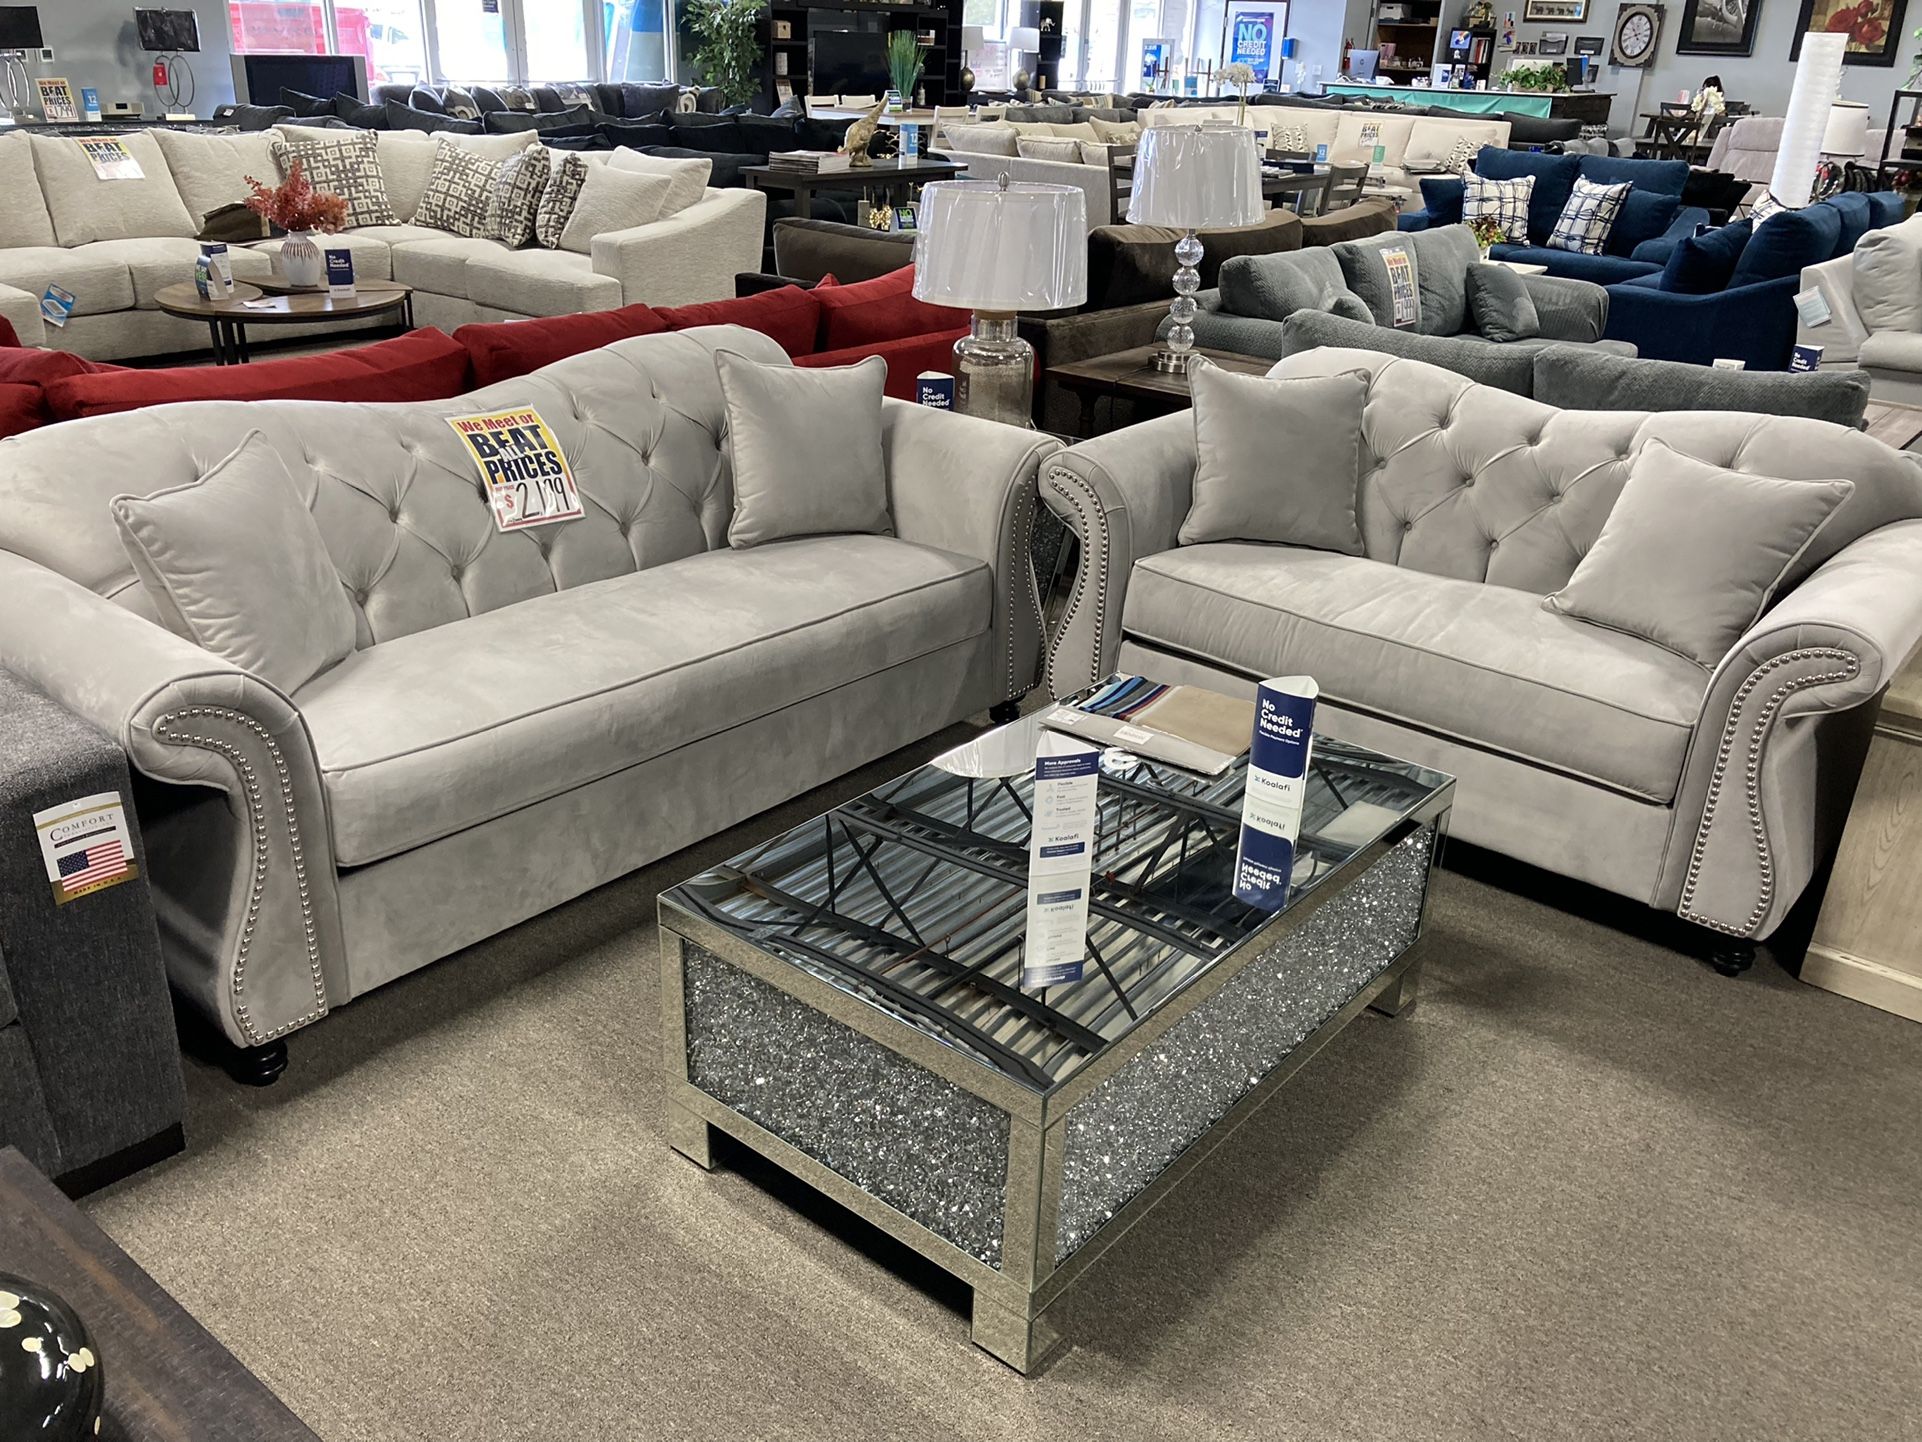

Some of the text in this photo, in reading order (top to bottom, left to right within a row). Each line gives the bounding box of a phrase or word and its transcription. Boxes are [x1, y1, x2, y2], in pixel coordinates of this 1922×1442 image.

[1238, 24, 1267, 42] NO
[40, 86, 68, 96] BEAT
[43, 96, 72, 106] PRICES
[88, 95, 97, 104] 12
[83, 142, 123, 152] BEAT
[90, 152, 130, 163] PRICES
[1389, 265, 1410, 284] BEAT
[457, 414, 535, 433] We Meet or
[466, 424, 548, 459] BEAT
[498, 444, 525, 462] ALL
[484, 450, 563, 485] PRICES
[504, 494, 514, 509] $
[1262, 699, 1276, 711] No
[1261, 709, 1293, 726] Credit
[1260, 718, 1301, 738] Needed
[1261, 777, 1290, 791] Koalafi
[50, 813, 114, 842] COMFORT
[1055, 833, 1079, 841] Koalafi
